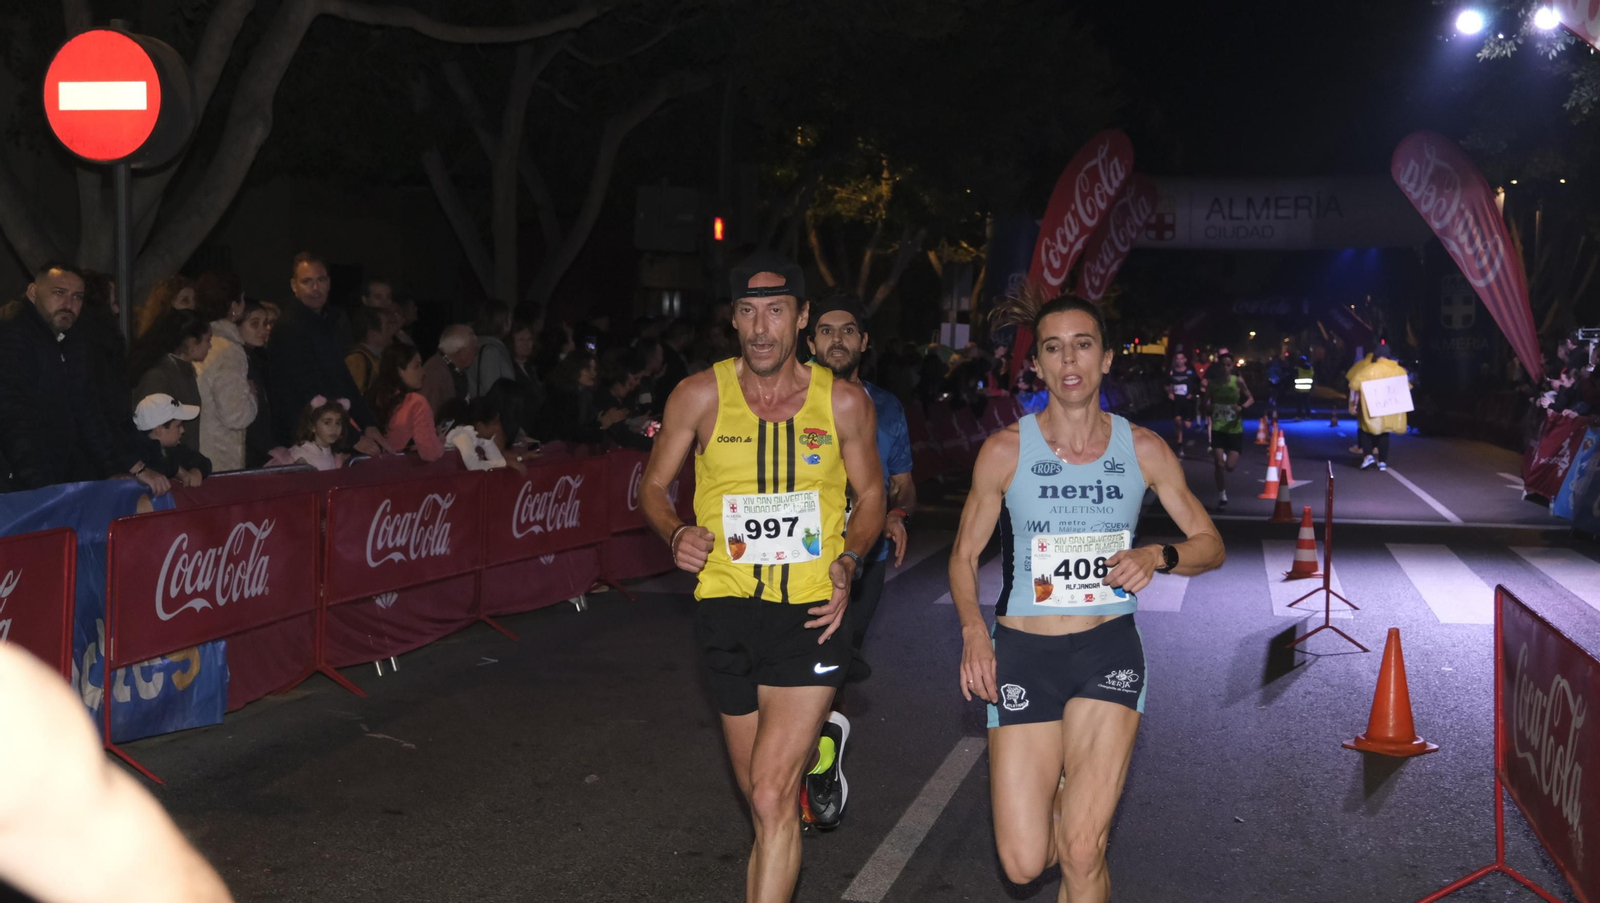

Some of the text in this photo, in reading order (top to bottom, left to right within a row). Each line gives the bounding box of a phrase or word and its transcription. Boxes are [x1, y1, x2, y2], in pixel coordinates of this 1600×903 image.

[1040, 137, 1126, 287] Coca-Cola
[1205, 192, 1343, 221] ALMERÍA
[1204, 225, 1275, 240] CIUDAD
[717, 434, 743, 443] daen
[1033, 462, 1061, 474] TROPS
[743, 497, 755, 505] XIV
[756, 496, 772, 505] SAN
[1038, 479, 1123, 505] nerja
[512, 474, 585, 539] Coca-Cola
[744, 505, 771, 514] CIUDAD
[772, 504, 782, 513] DE
[1049, 505, 1114, 514] ATLETISMO
[366, 492, 457, 568] Coca-Cola
[745, 516, 799, 540] 997
[1054, 537, 1067, 545] XIV
[1068, 536, 1085, 545] SAN
[1054, 545, 1082, 554] CIUDAD
[1083, 544, 1093, 553] DE
[155, 517, 277, 621] Coca-Cola
[1053, 556, 1109, 580] 408
[1513, 641, 1587, 831] Coca-Cola
